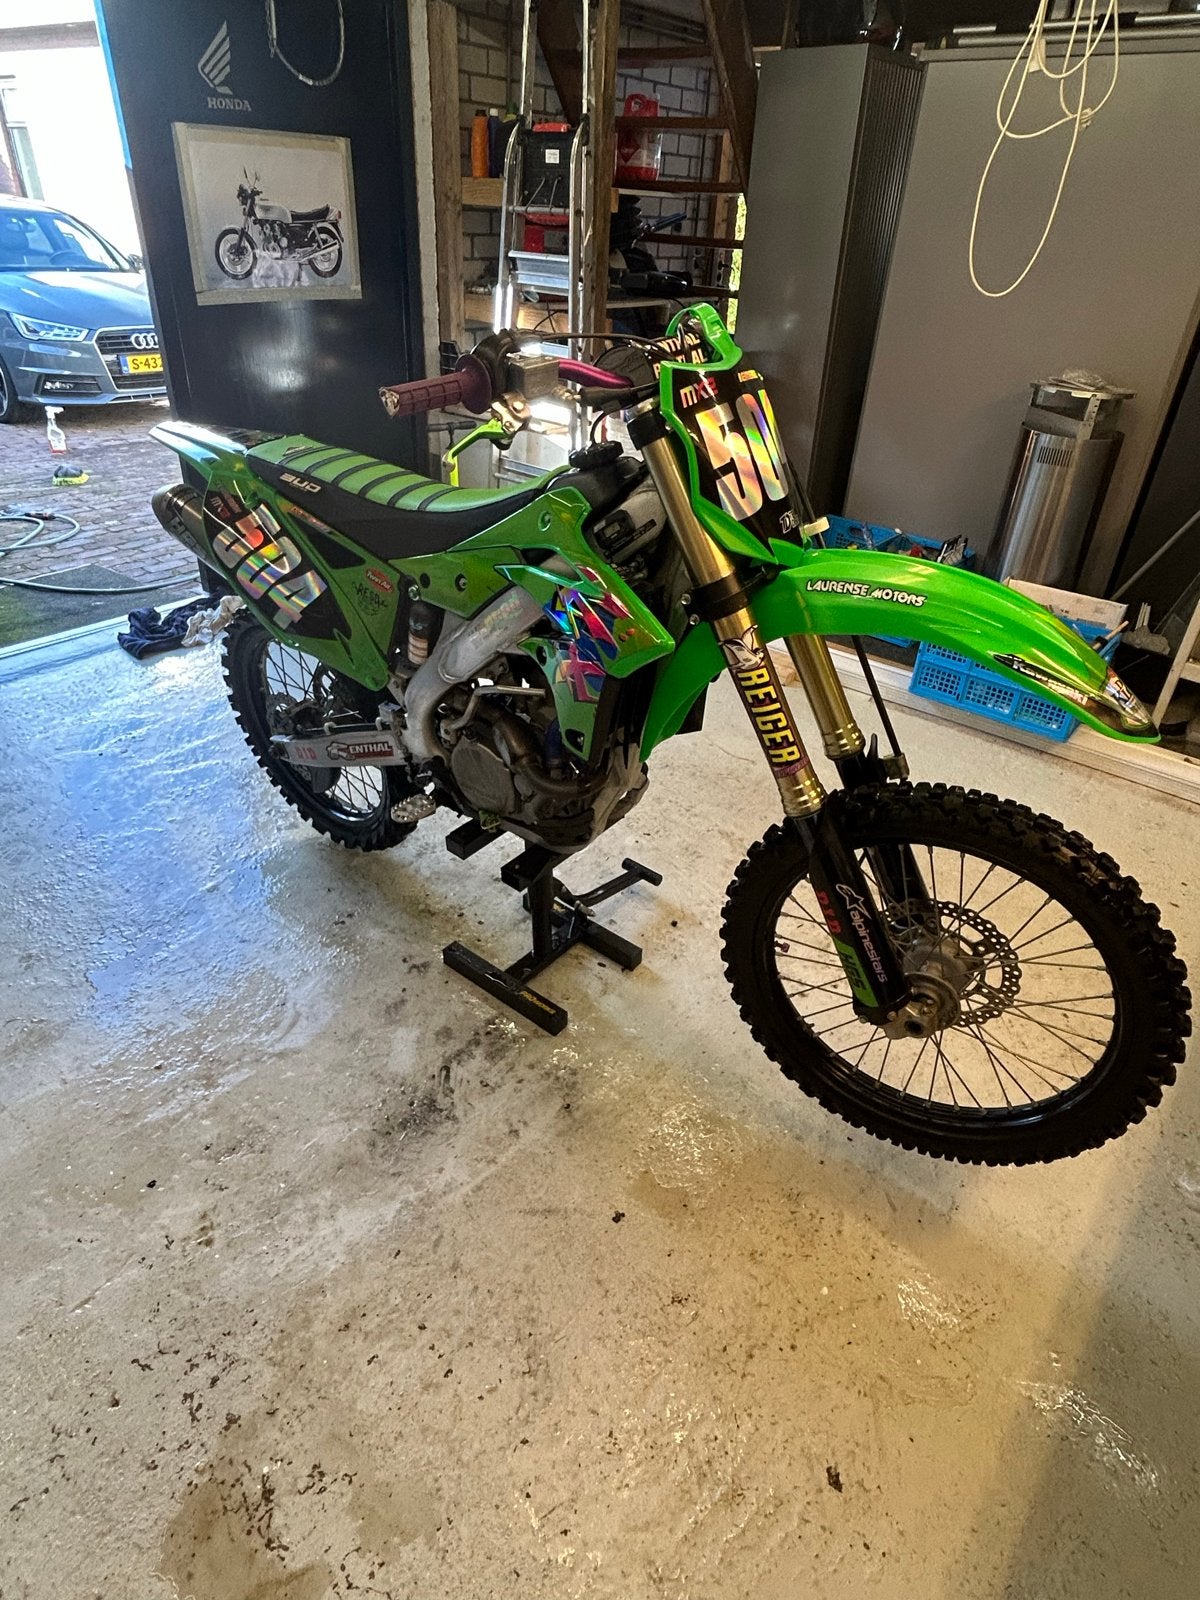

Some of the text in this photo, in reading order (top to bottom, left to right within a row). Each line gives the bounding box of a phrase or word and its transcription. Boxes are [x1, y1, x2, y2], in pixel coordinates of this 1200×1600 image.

[207, 96, 252, 111] HONDA
[131, 356, 163, 371] S-43
[280, 472, 321, 493] BUD
[806, 579, 926, 607] LAURENSE MOTORS
[737, 666, 801, 763] REIGER
[849, 908, 888, 983] alpinestars
